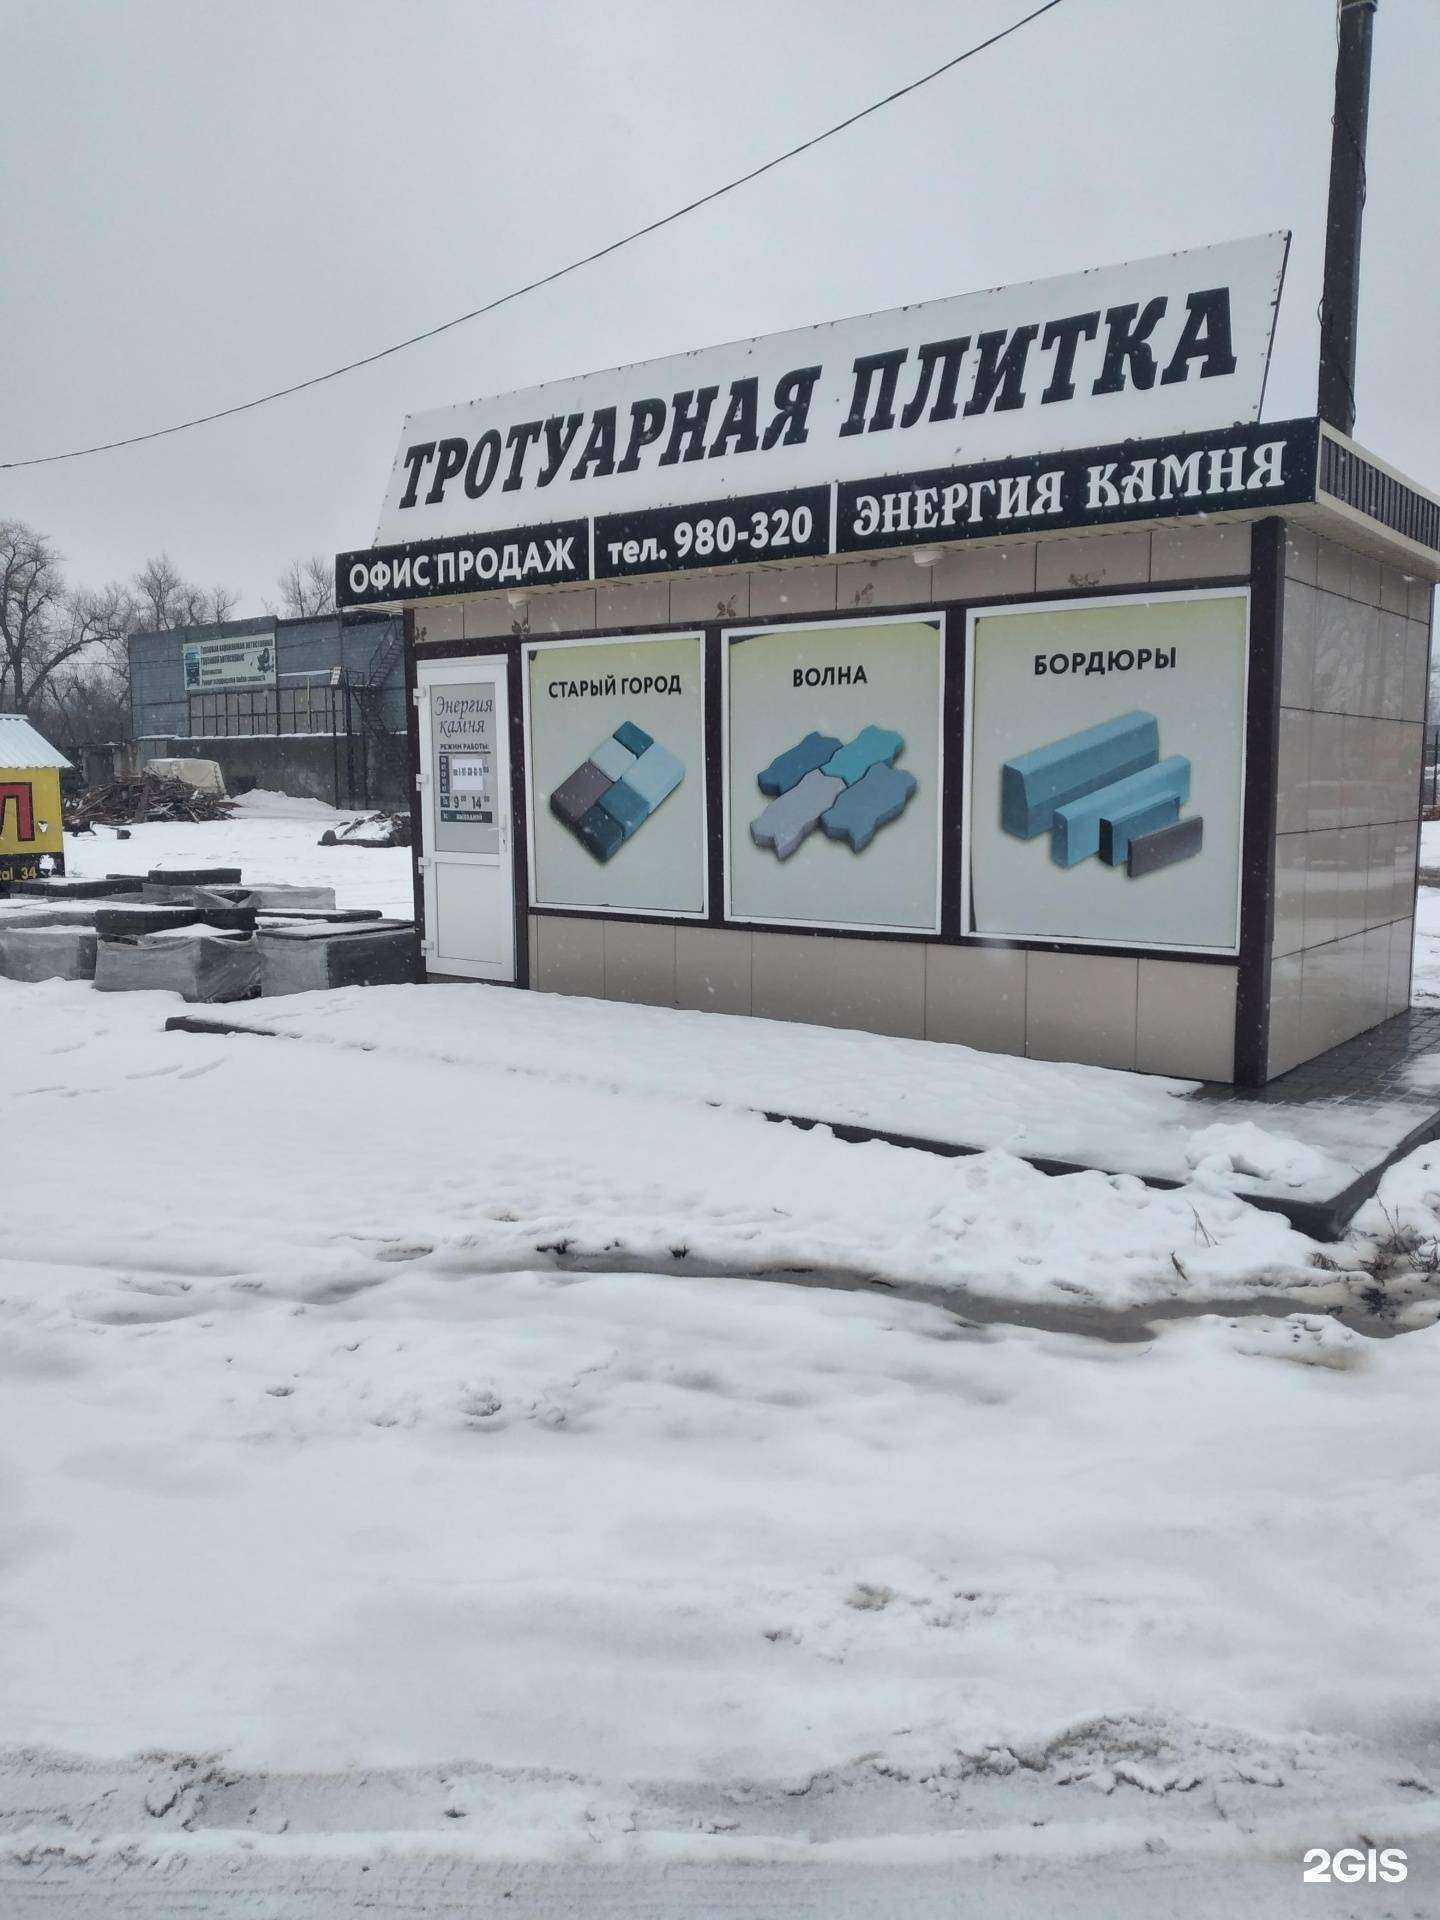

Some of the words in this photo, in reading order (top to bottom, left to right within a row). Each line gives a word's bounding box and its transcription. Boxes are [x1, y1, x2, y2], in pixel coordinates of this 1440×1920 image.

[399, 365, 822, 509] ТРОТУАРНАЯ
[839, 287, 1237, 438] ПЛИТКА
[853, 470, 1065, 536] ЭНЕРГИЯ
[1085, 440, 1287, 509] КАМНЯ
[607, 538, 668, 565] тел.
[673, 505, 813, 558] 980-320
[349, 555, 430, 593] ОФИС
[437, 536, 575, 583] ПРОДАЖ
[792, 664, 868, 688] ВОЛНА
[1034, 647, 1176, 676] БОРДЮРЫ
[548, 674, 616, 698] СТАРЫЙ
[621, 674, 682, 695] ГОРОД
[435, 696, 493, 719] Энергия
[439, 719, 485, 737] камня
